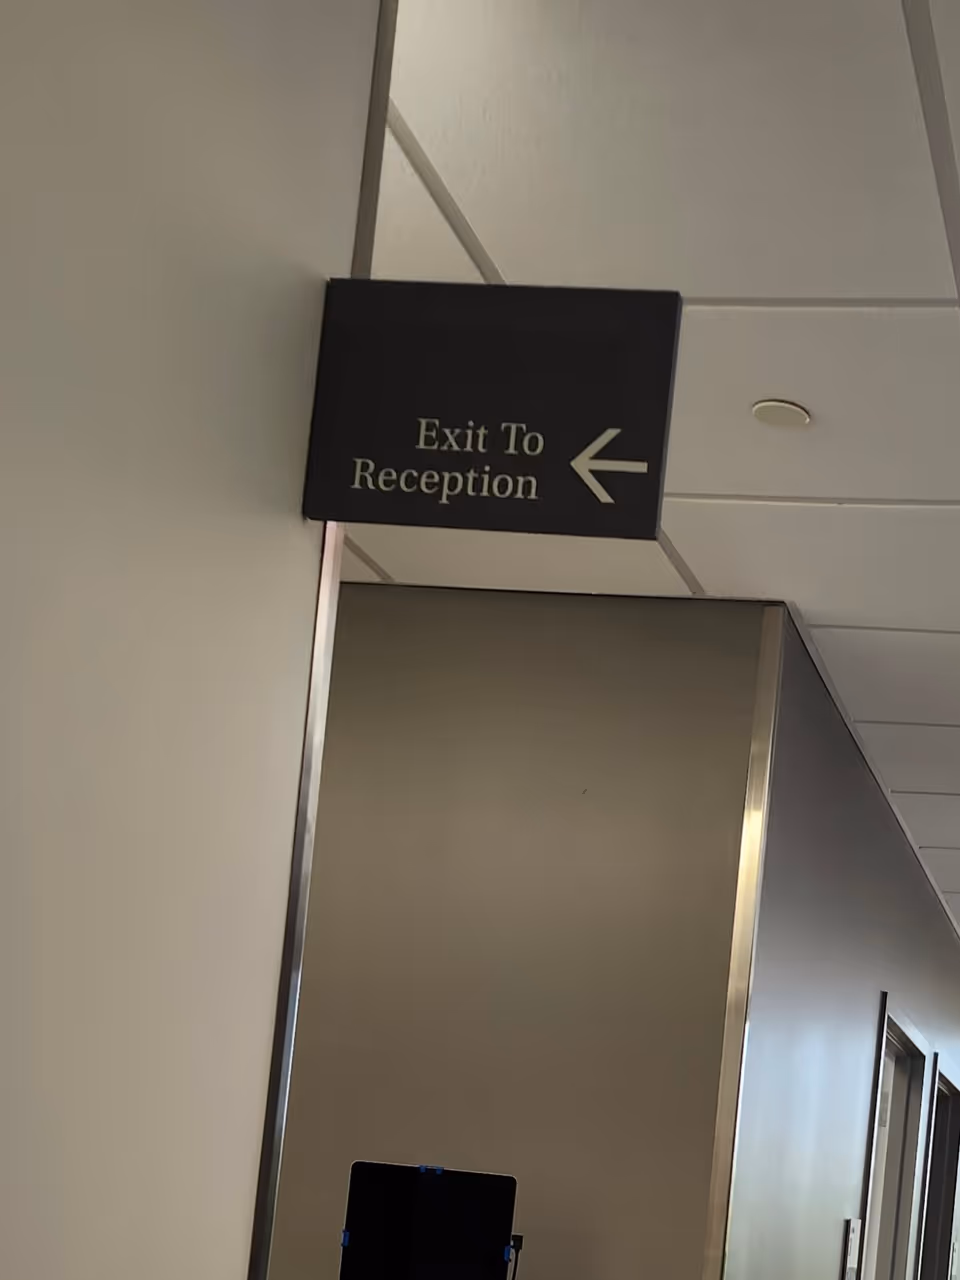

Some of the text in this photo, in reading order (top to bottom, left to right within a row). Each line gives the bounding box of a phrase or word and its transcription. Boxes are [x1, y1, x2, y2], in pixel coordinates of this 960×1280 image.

[415, 418, 545, 456] Exit To
[351, 458, 539, 504] Reception
